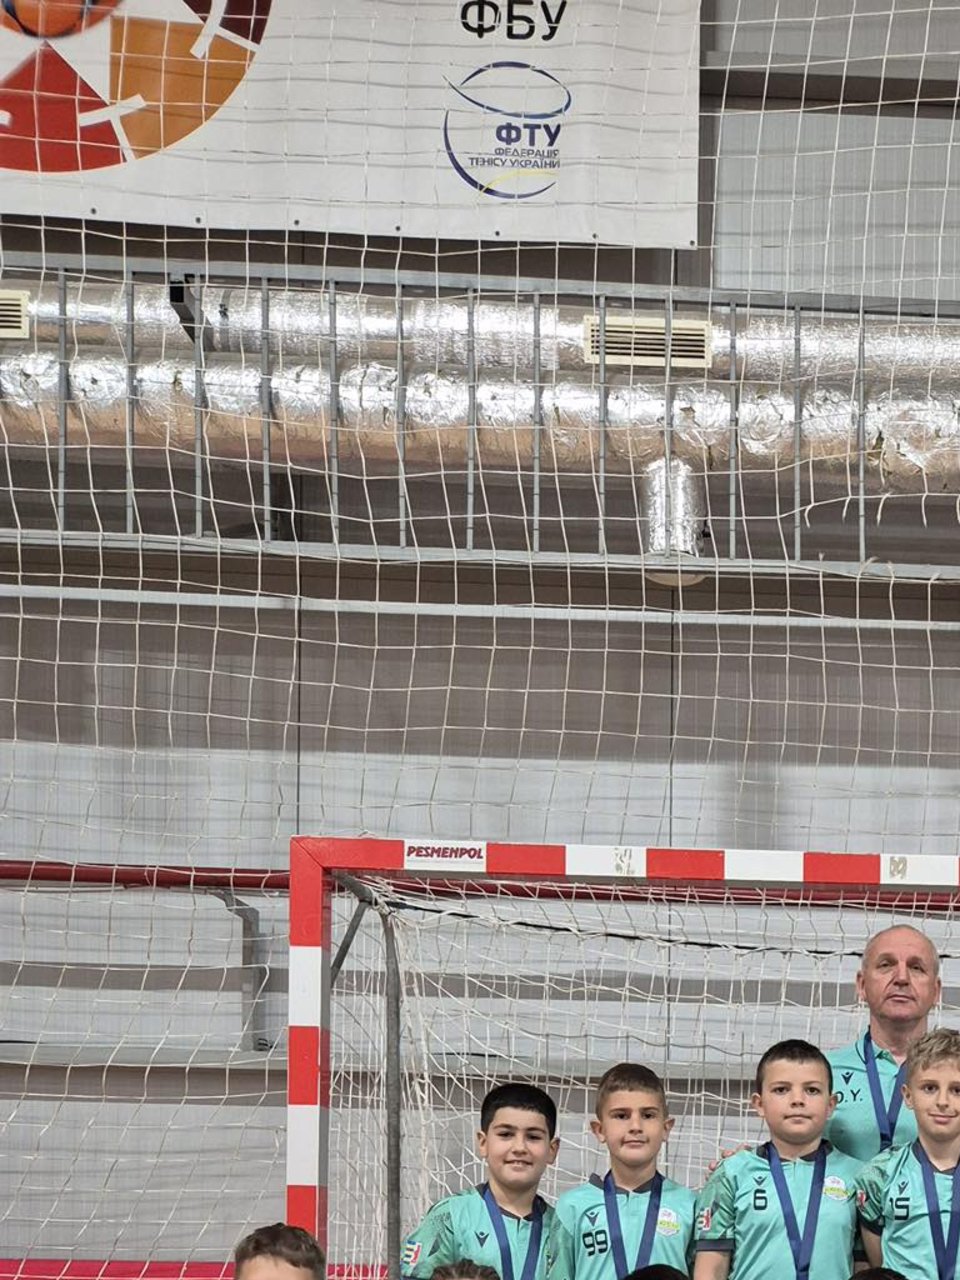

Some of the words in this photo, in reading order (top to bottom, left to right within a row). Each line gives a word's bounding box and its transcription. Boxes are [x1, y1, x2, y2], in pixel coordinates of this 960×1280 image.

[461, 0, 567, 40] ФБУ
[495, 122, 561, 147] ФТУ
[469, 157, 507, 167] ТЕНІСУ
[509, 158, 560, 169] УКРАЇНИ
[494, 147, 560, 159] ФЕДЕРАЦІЯ
[407, 846, 484, 859] PESMENPOL
[754, 1189, 768, 1211] 6
[889, 1197, 910, 1220] 15
[582, 1230, 608, 1256] 99
